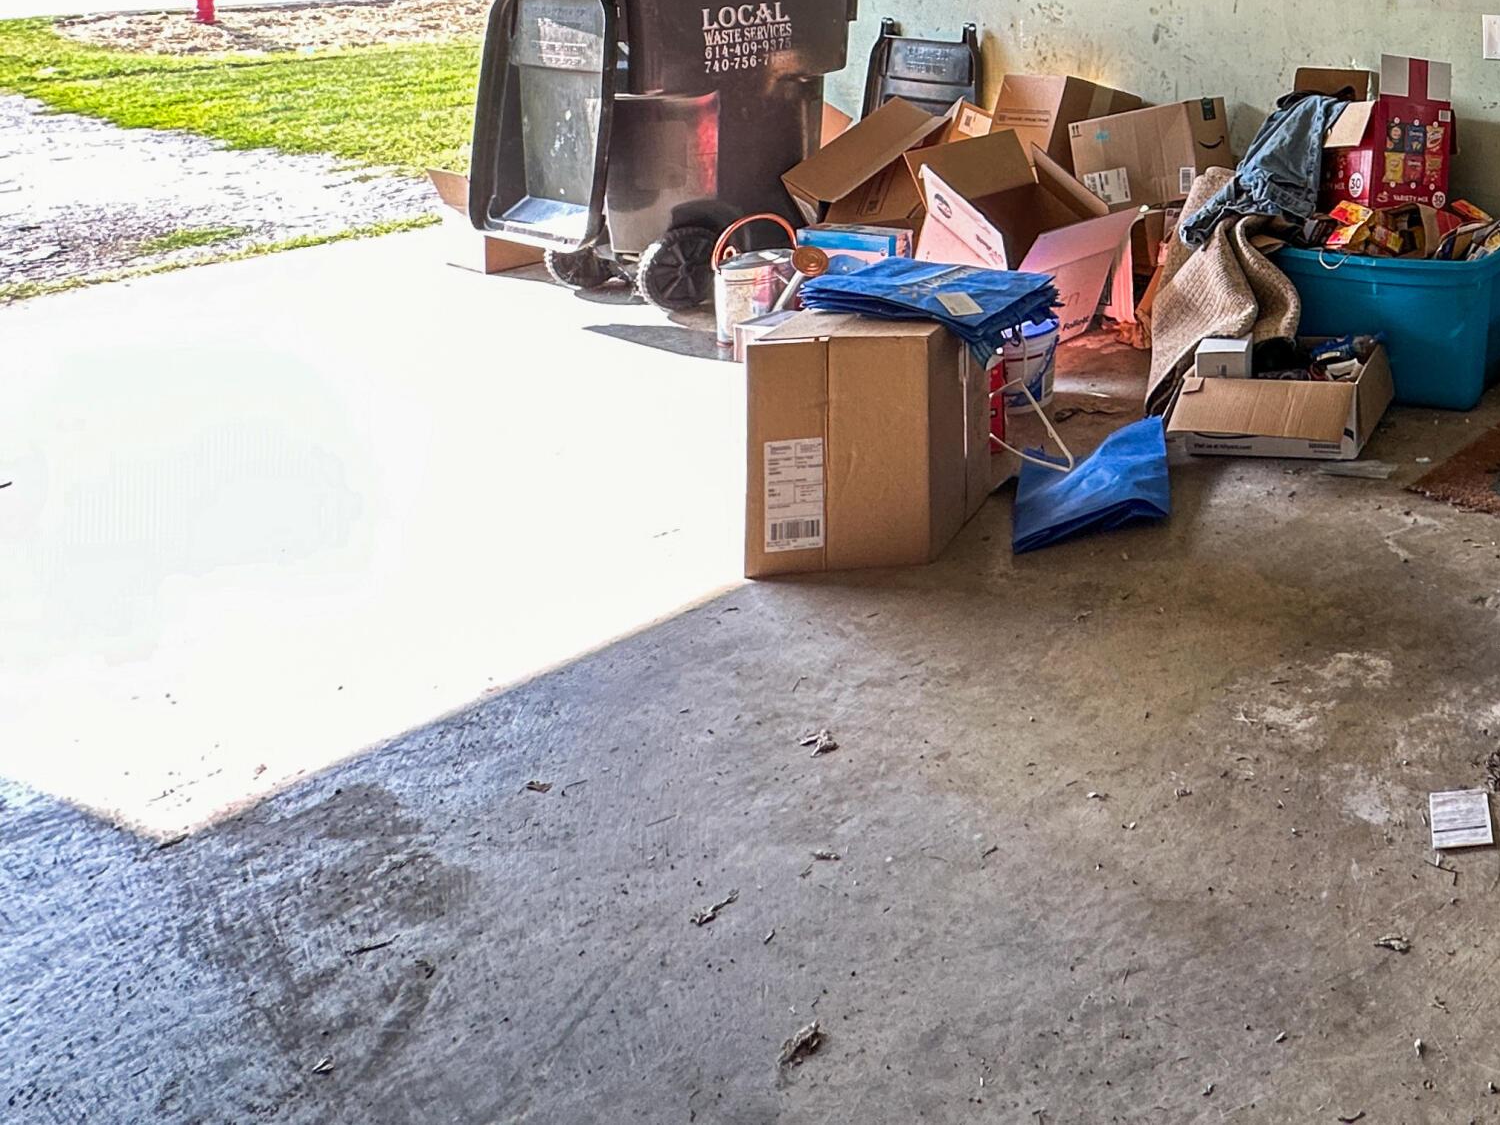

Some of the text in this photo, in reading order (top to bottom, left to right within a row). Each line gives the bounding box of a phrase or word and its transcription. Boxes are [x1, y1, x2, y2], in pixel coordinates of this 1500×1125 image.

[701, 1, 791, 30] LOCAL
[703, 23, 792, 46] WASTE SERVICES
[705, 37, 792, 59] 614-409-9375
[1350, 178, 1361, 189] 30
[1393, 194, 1416, 202] VARIETY
[1434, 195, 1444, 204] 30
